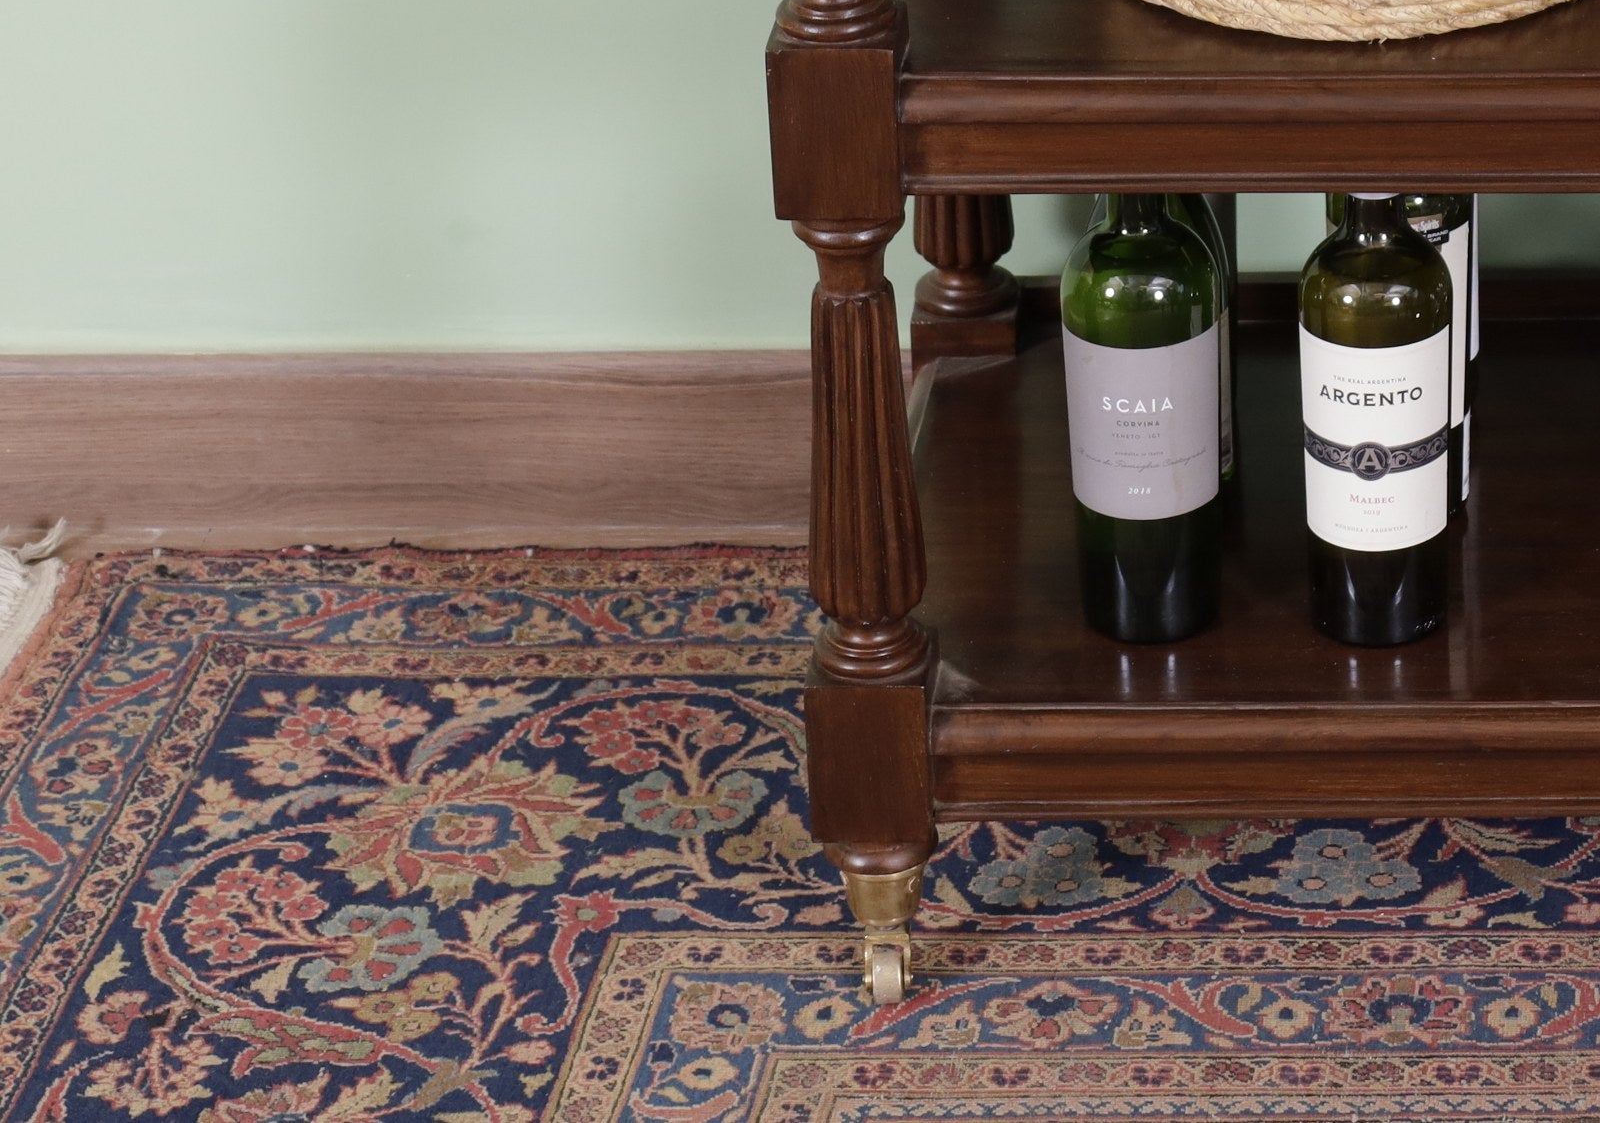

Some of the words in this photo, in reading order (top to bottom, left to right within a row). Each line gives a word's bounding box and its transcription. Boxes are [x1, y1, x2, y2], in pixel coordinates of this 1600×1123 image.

[1367, 376, 1407, 385] ARGENTINA
[1102, 396, 1174, 413] SCAIA
[1320, 384, 1423, 406] ARGENTO
[1358, 448, 1384, 470] A
